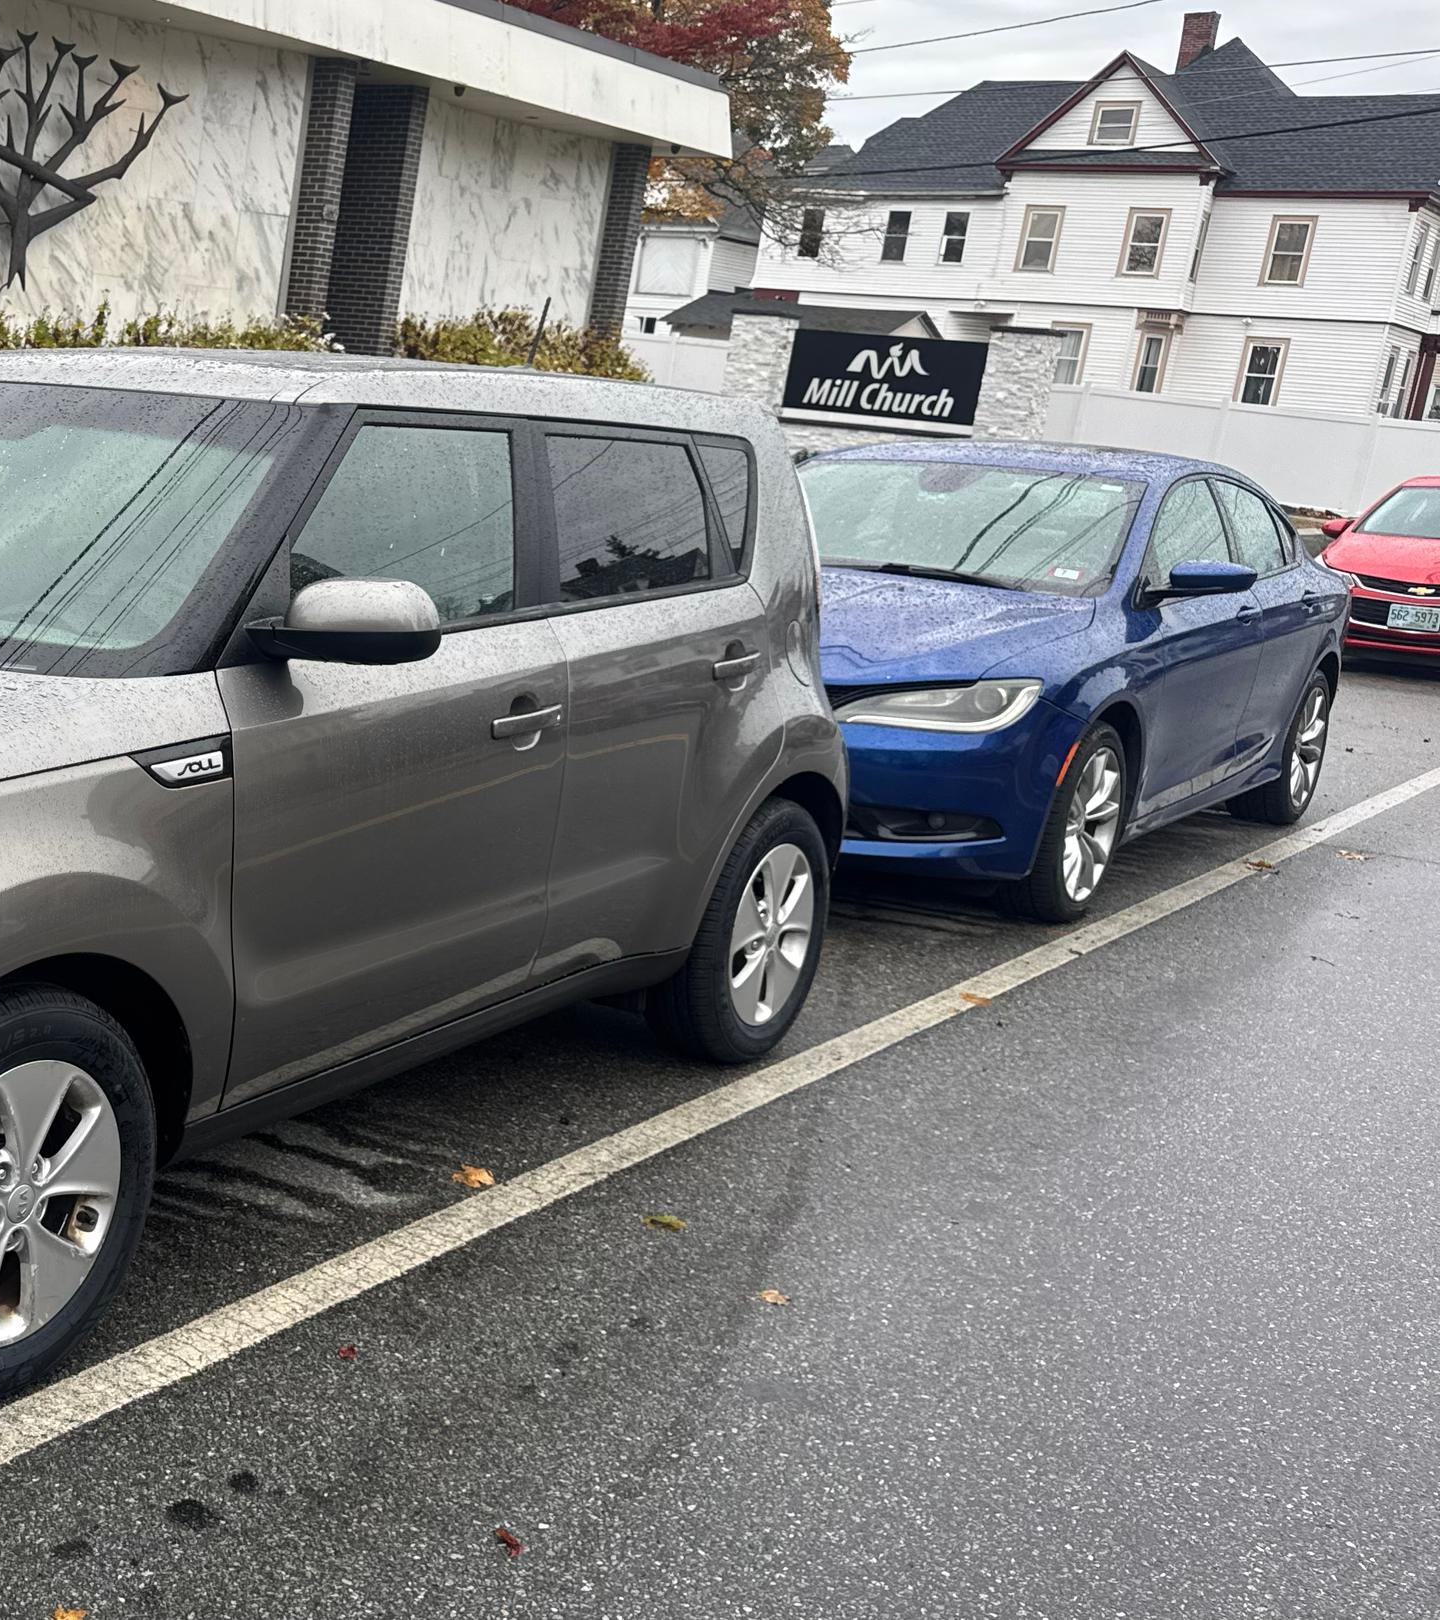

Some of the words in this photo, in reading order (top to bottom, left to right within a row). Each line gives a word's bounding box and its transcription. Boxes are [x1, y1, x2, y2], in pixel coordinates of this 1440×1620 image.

[802, 377, 859, 408] Mill
[860, 382, 954, 417] Church
[1390, 609, 1409, 621] 562
[1414, 611, 1439, 624] 5973
[177, 758, 221, 776] SOUL
